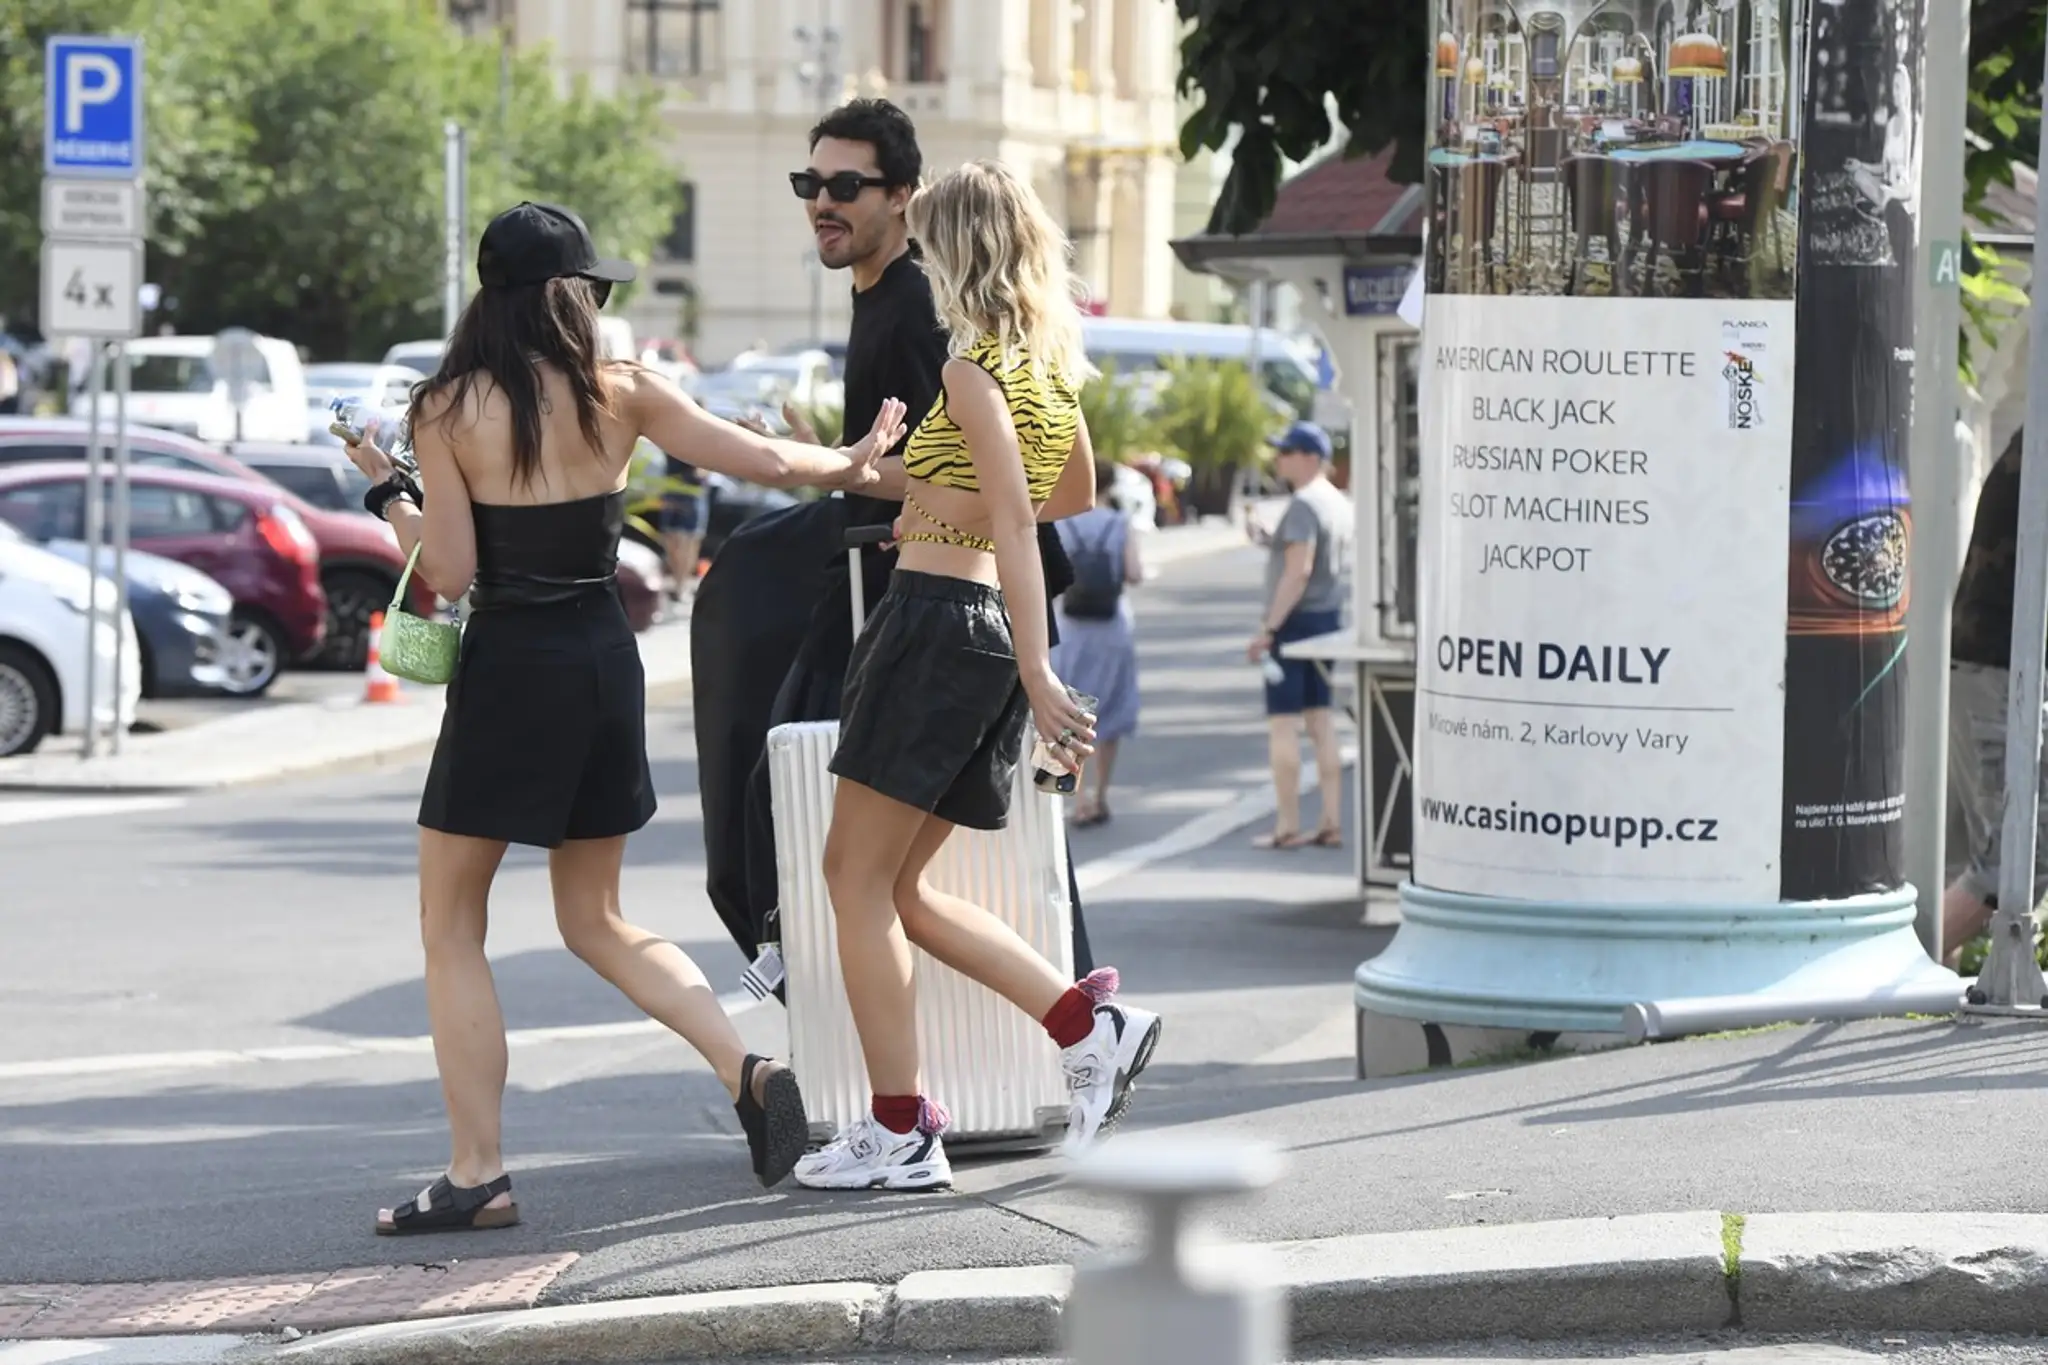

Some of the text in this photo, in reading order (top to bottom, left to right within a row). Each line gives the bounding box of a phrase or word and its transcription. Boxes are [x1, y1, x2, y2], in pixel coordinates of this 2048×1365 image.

[65, 53, 122, 133] P
[63, 266, 114, 309] 4x
[1436, 346, 1695, 377] AMERICAN ROULETTE
[1472, 397, 1615, 429] BLACK JACK
[1737, 360, 1753, 429] NOSKE
[1453, 444, 1648, 475] RUSSIAN POKER
[1450, 493, 1650, 525] SLOT MACHINES
[1479, 544, 1592, 574] JACKPOT
[1437, 635, 1671, 684] OPEN DAILY
[1472, 718, 1514, 742] nám.
[1520, 721, 1536, 746] 2,
[1544, 724, 1629, 753] Karlovy
[1636, 728, 1689, 755] Vary
[1421, 797, 1719, 848] www.casinopupp.cz
